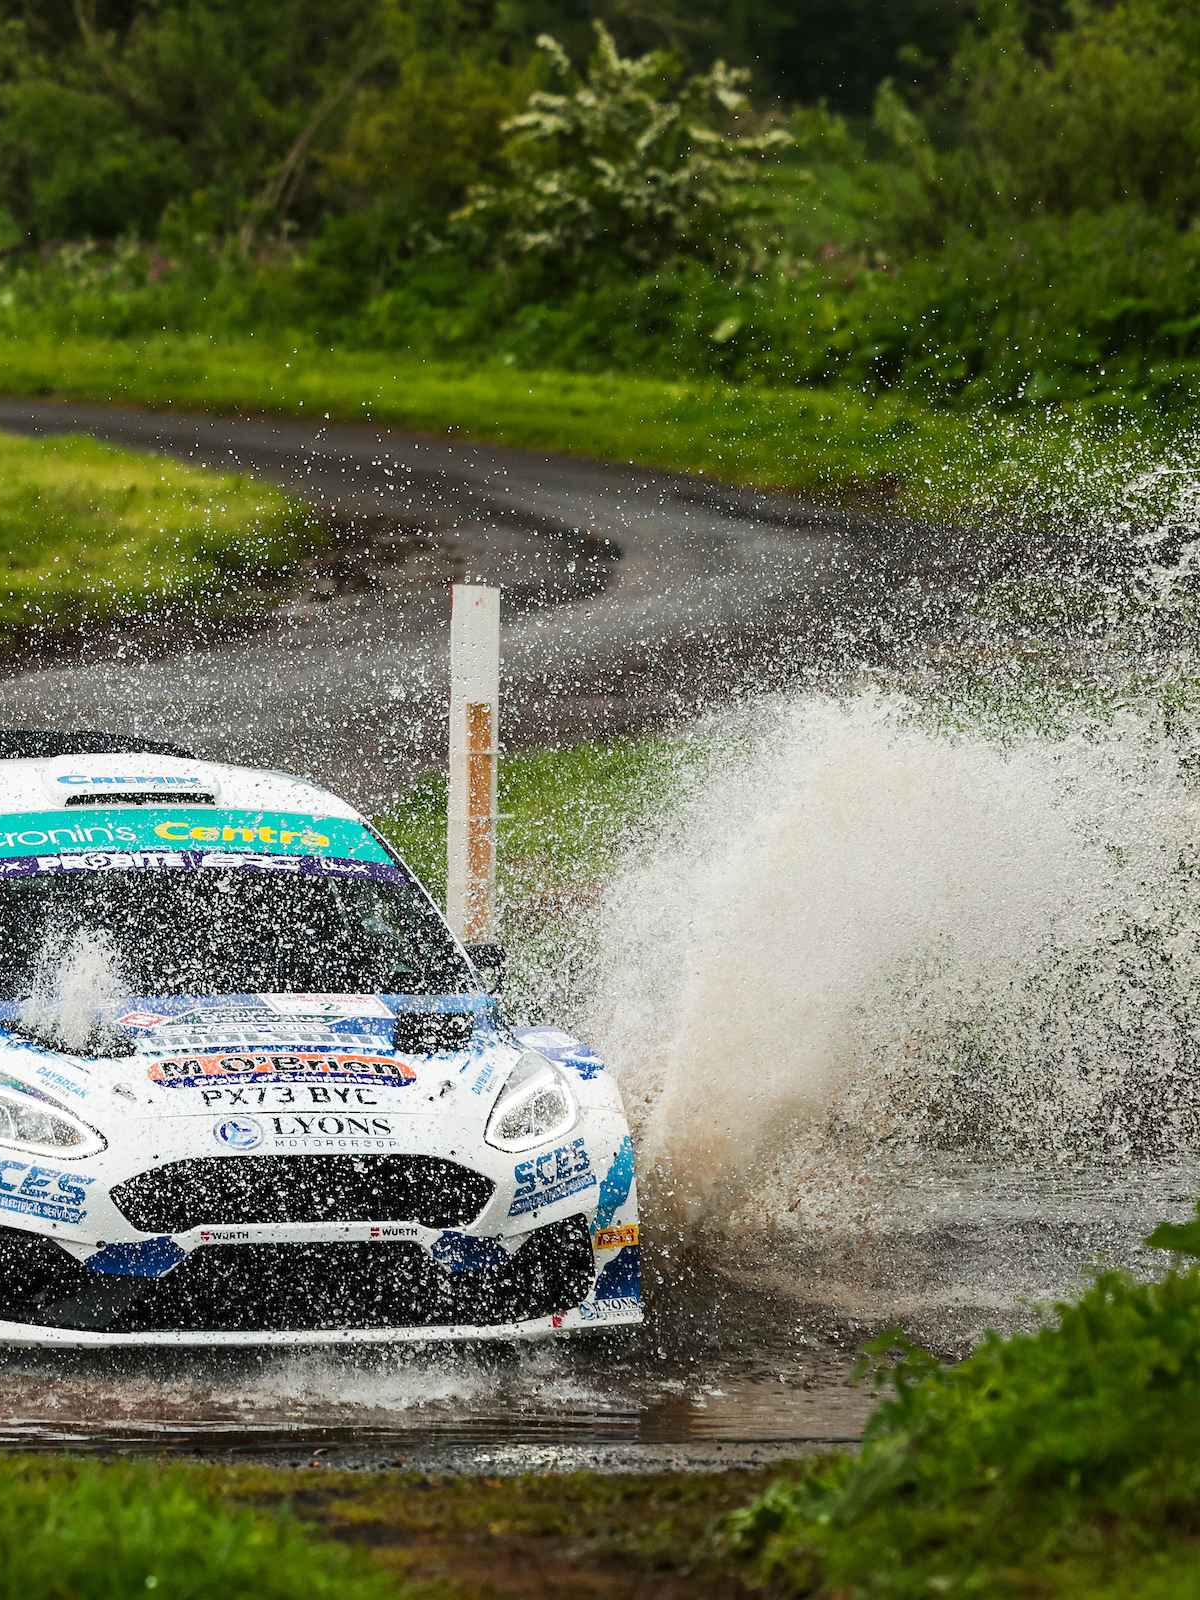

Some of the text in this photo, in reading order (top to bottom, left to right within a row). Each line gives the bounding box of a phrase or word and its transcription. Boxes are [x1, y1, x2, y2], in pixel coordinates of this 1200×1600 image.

[57, 775, 201, 785] CREMIN
[154, 822, 330, 847] Centra
[37, 852, 186, 872] PROBITE
[161, 1054, 402, 1079] M O'Brien
[36, 1066, 90, 1099] DAYBREAK
[193, 1074, 251, 1085] Group
[281, 1073, 385, 1084] Companies
[201, 1086, 377, 1107] PX73 BYC
[273, 1117, 392, 1136] LYONS
[275, 1139, 397, 1148] MOTORGROUP
[514, 1137, 590, 1198] SCES
[0, 1197, 41, 1214] ELECTRICAL
[42, 1206, 80, 1221] SERVICES
